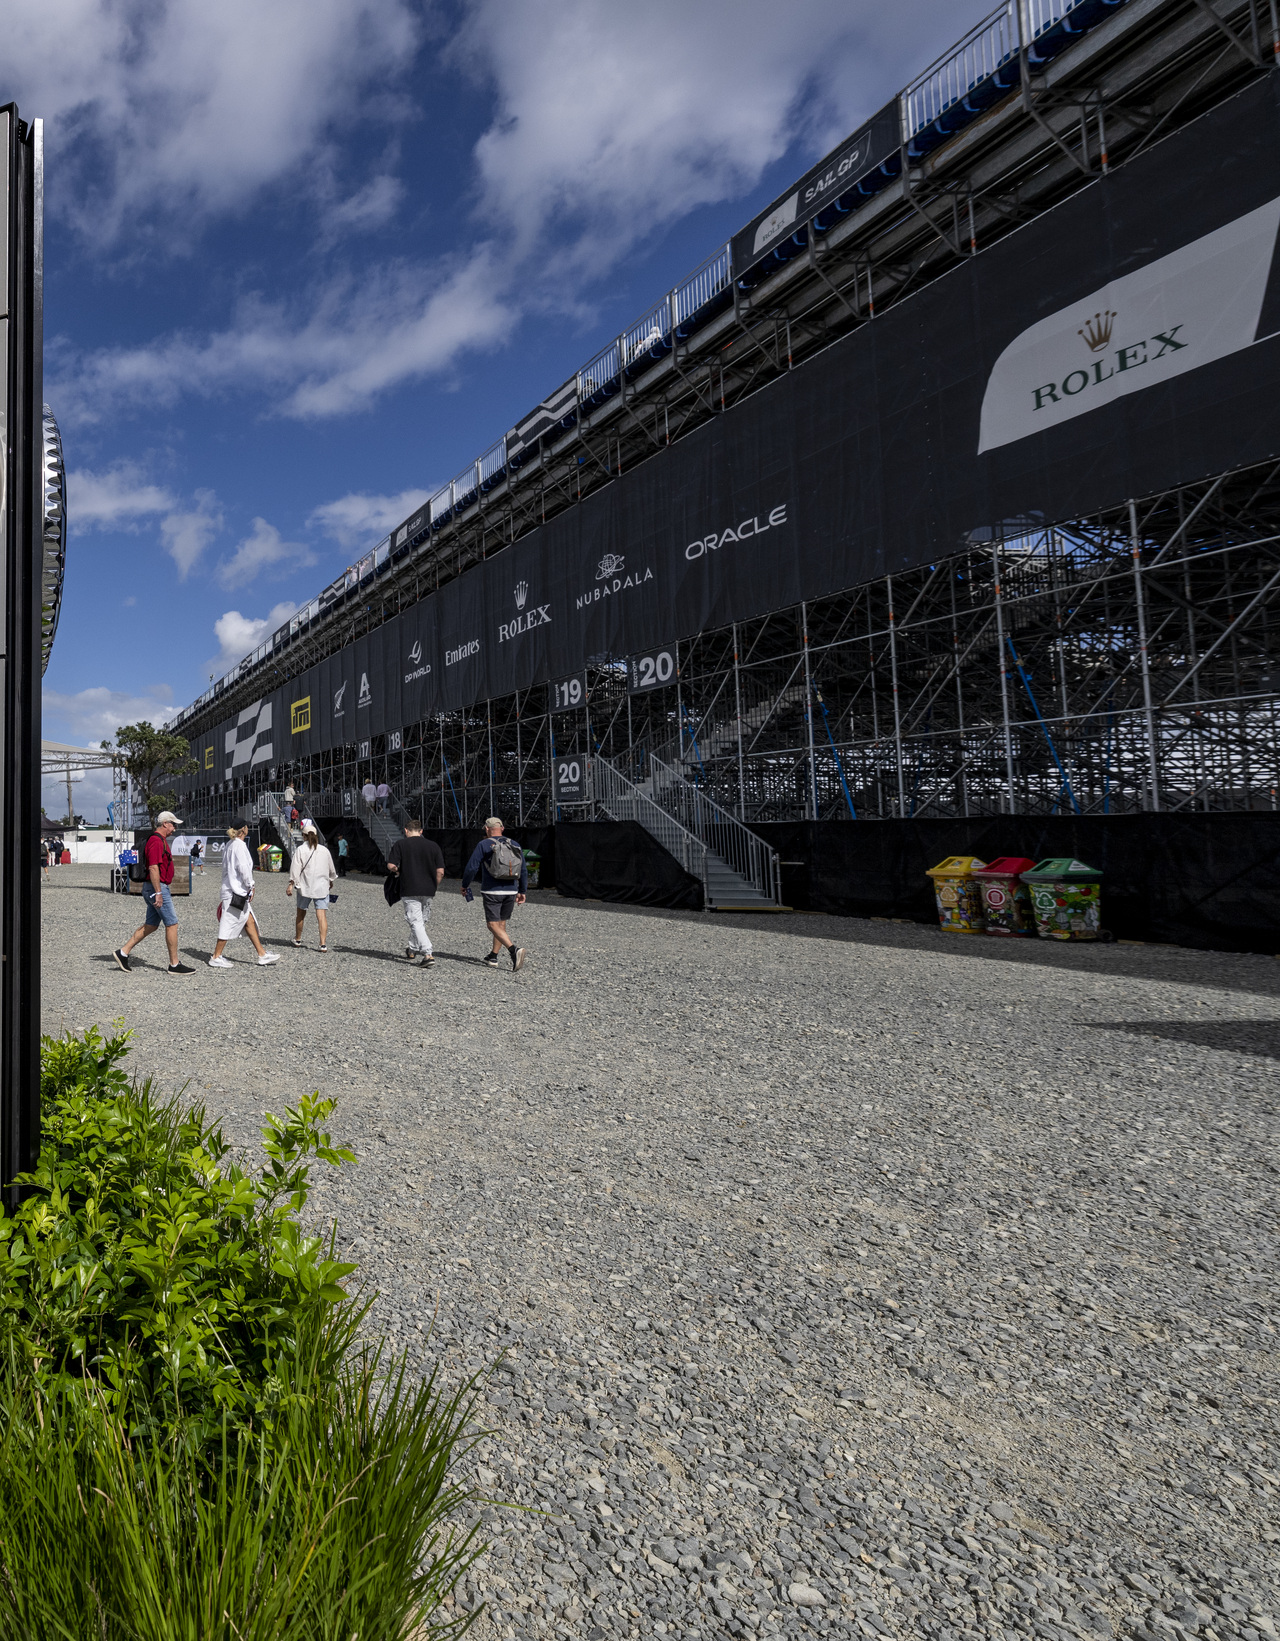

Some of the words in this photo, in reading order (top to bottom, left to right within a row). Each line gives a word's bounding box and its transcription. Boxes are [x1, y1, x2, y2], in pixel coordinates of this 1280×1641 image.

[762, 218, 785, 242] ROLEX
[1031, 324, 1189, 412] ROLEX
[685, 504, 787, 560] ORACLE
[498, 604, 552, 643] ROLEX
[445, 638, 480, 667] Emirates
[412, 664, 432, 679] WORLD
[639, 652, 674, 686] 20
[560, 679, 581, 706] 19
[361, 741, 369, 758] 17
[391, 731, 401, 750] 18
[558, 761, 580, 784] 20
[344, 792, 351, 805] 18
